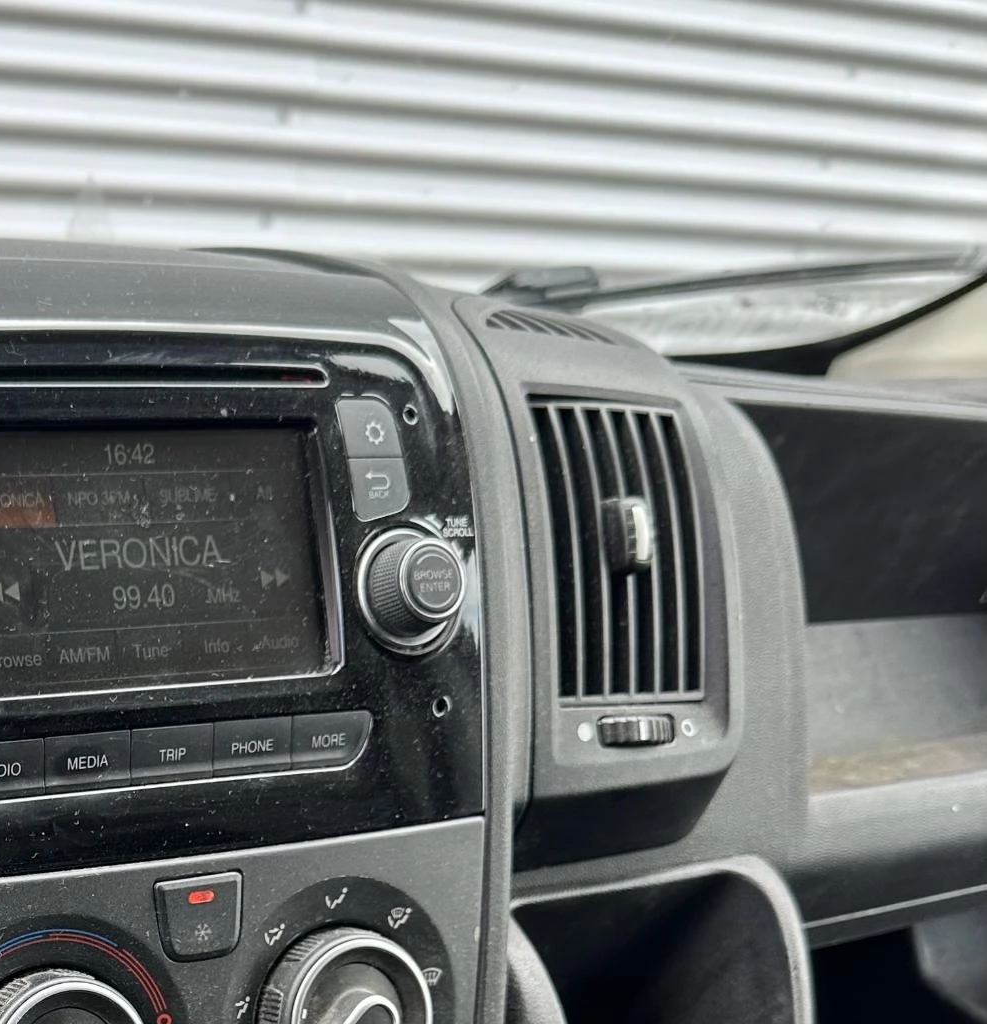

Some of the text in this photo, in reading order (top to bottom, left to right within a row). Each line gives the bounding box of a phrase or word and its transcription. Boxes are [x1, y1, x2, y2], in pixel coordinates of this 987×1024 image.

[104, 443, 155, 465] 16:42
[67, 491, 98, 506] NPO
[445, 517, 469, 528] TUNE
[442, 527, 474, 538] SCROLL
[57, 534, 222, 572] VERONICA
[413, 569, 454, 581] BROWSE
[419, 582, 451, 593] ENTER
[113, 583, 175, 610] 99.40
[132, 643, 170, 660] Tune
[203, 638, 230, 655] Info
[262, 635, 300, 651] Audio
[59, 646, 111, 665] AM/FM
[230, 738, 275, 755] PHONE
[311, 732, 347, 749] MORE
[66, 754, 109, 771] MEDIA
[159, 747, 188, 763] TRIP
